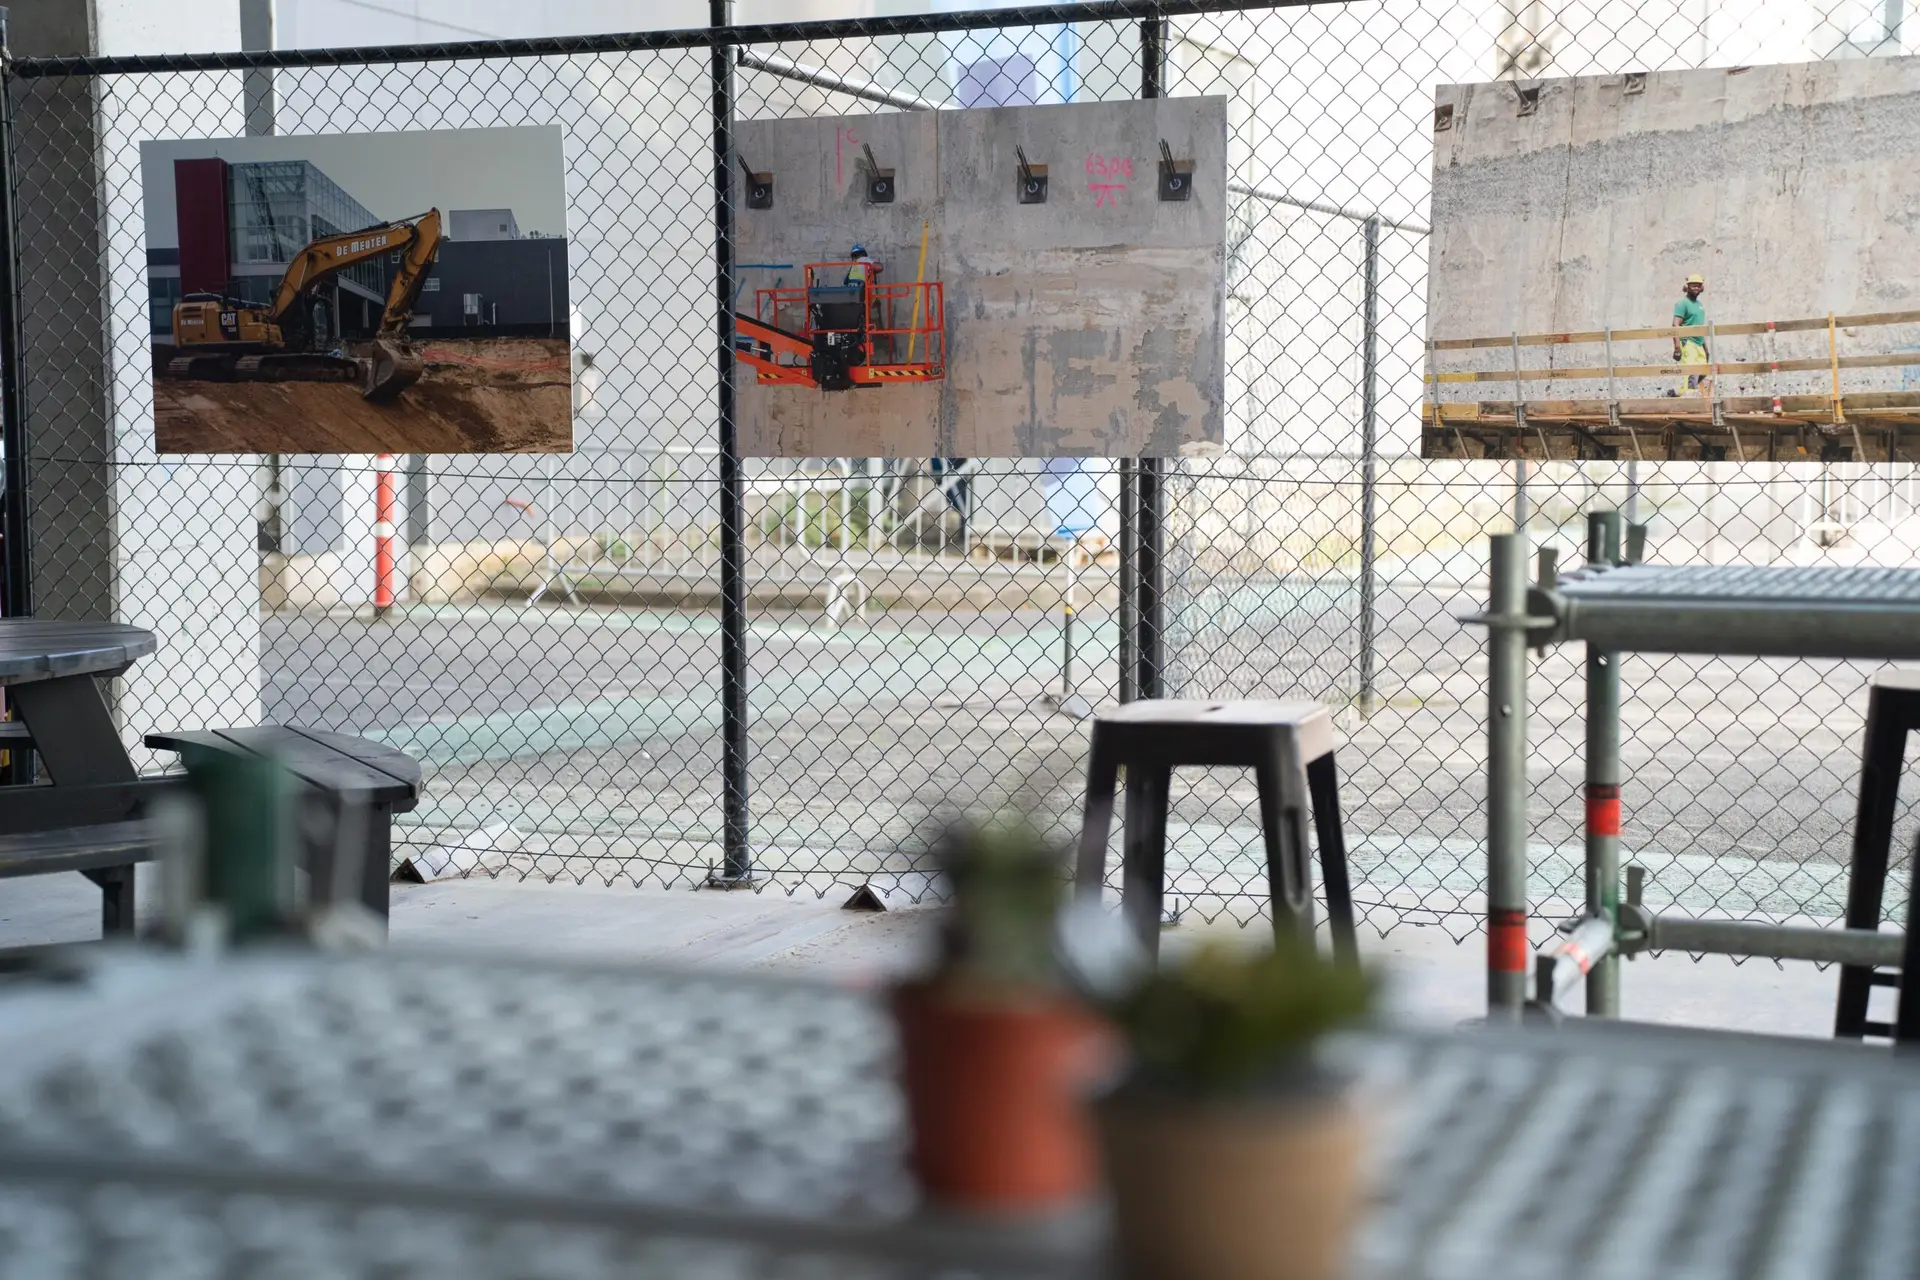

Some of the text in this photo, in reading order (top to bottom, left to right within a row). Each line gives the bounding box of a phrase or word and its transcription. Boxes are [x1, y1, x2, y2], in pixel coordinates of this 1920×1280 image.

[336, 235, 387, 257] DE MEUTER
[221, 312, 237, 326] CAT
